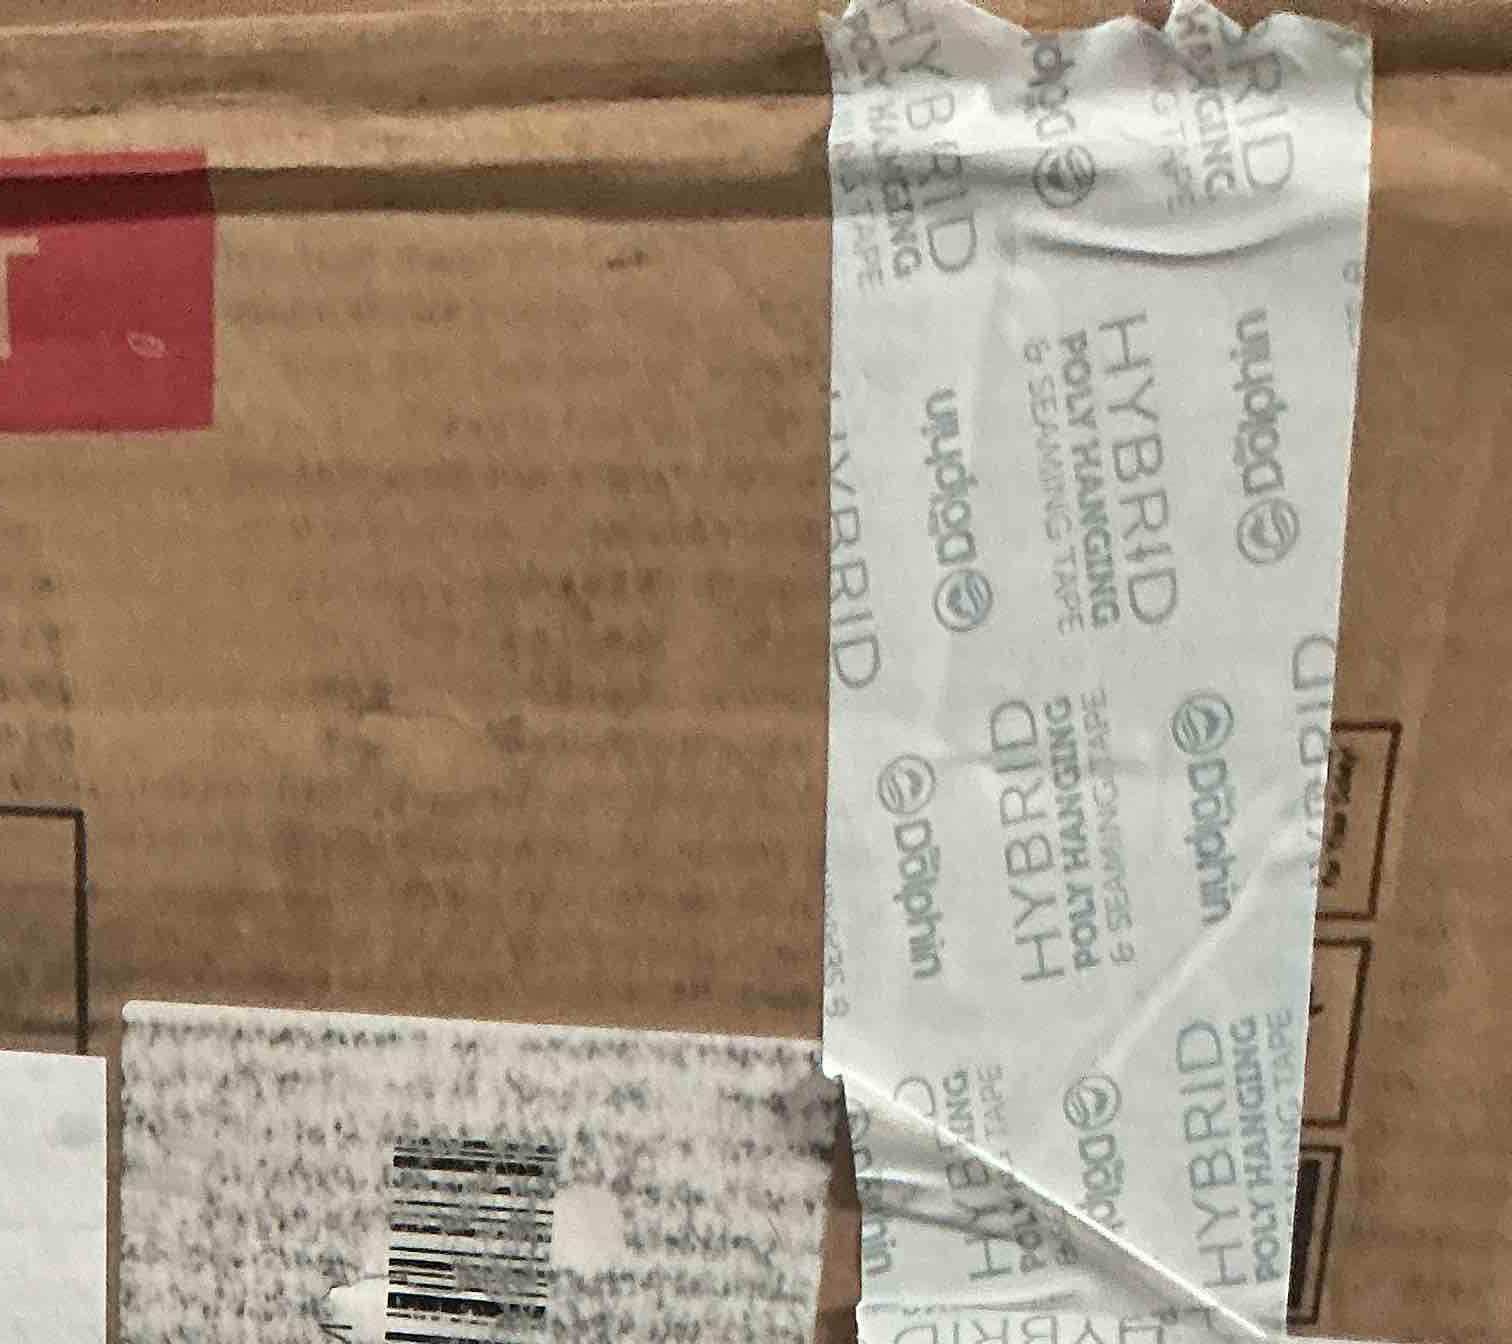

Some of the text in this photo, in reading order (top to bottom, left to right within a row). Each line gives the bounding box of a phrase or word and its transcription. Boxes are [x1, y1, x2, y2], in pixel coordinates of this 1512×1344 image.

[1059, 329, 1119, 628] POLY HANGING
[1099, 312, 1178, 626] HYBRID
[990, 699, 1065, 984] HYBRID
[1044, 695, 1098, 970] POLY HANGING
[1176, 1020, 1250, 1289] HYBRID
